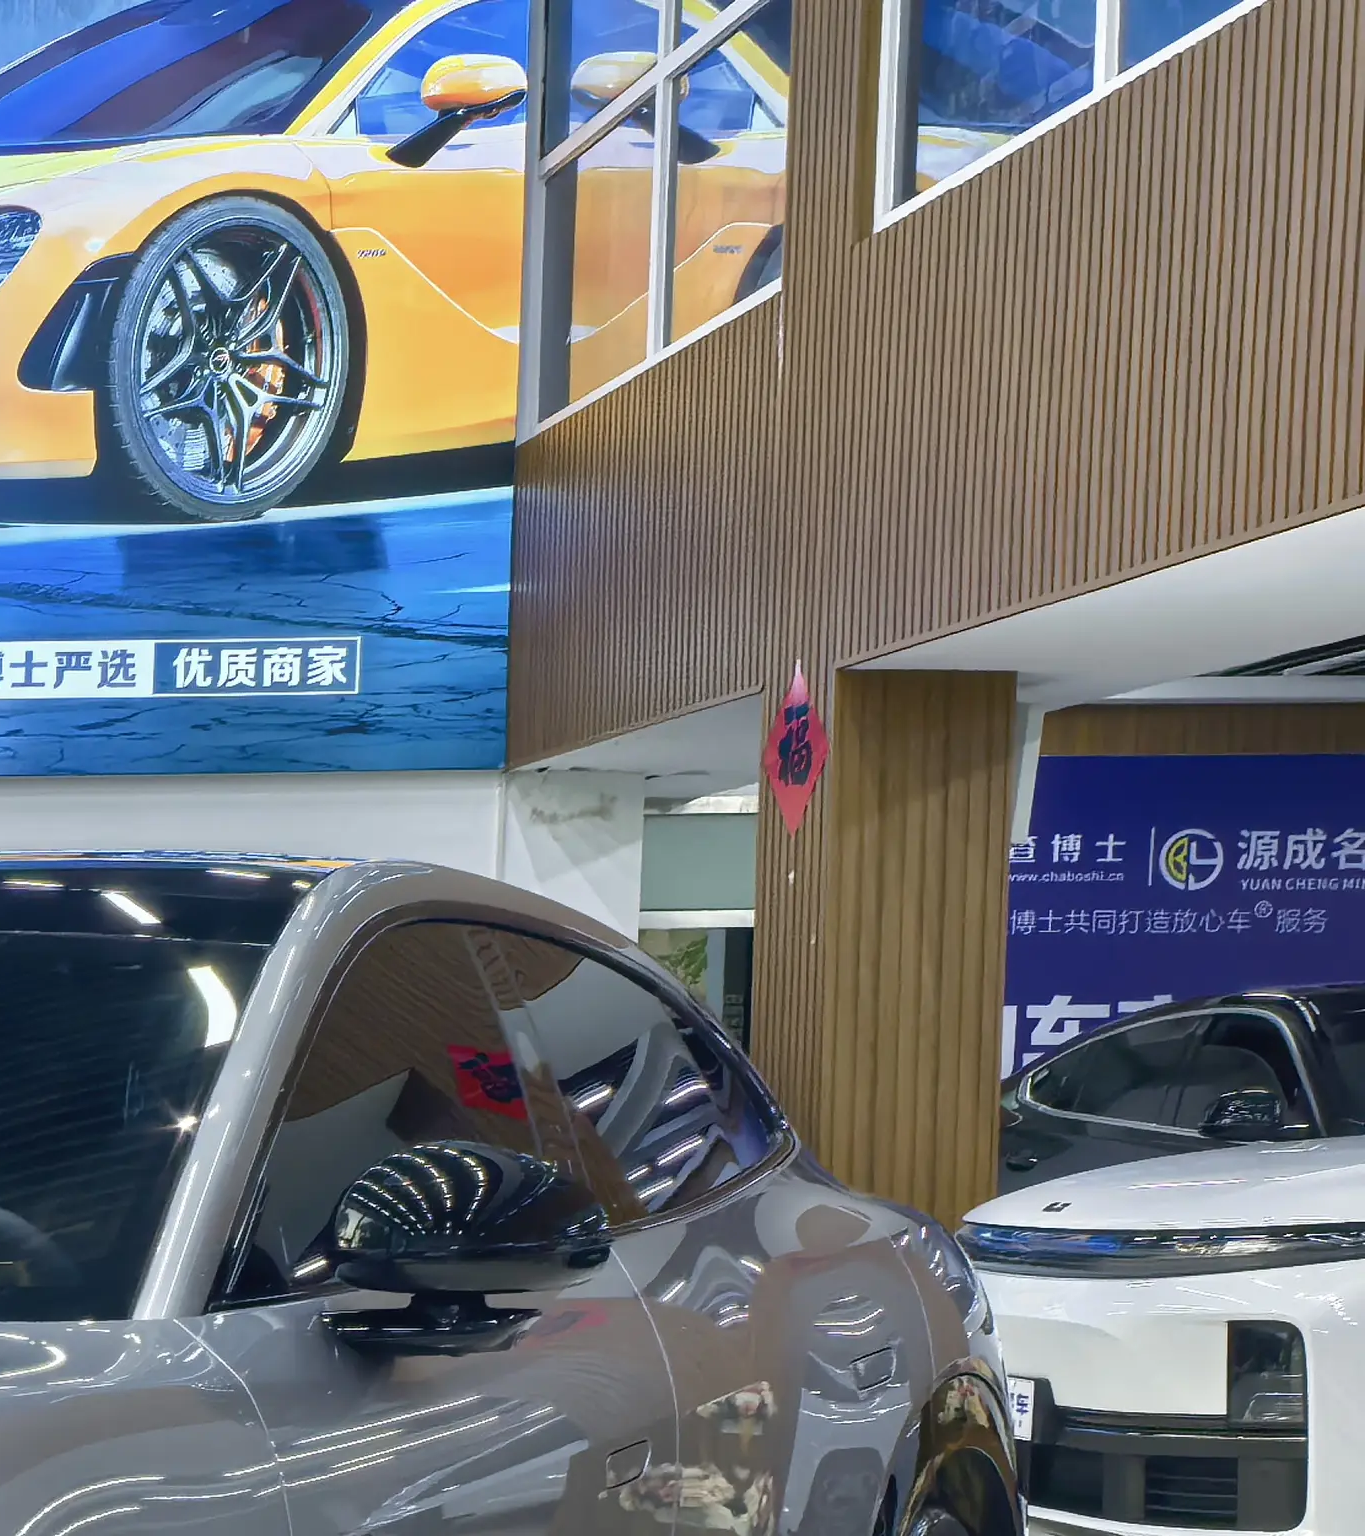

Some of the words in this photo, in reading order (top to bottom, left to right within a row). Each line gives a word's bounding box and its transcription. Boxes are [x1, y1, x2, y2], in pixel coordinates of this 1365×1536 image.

[172, 645, 348, 689] 优质商家
[1241, 878, 1282, 891] YUAN
[1285, 878, 1339, 891] CHENG
